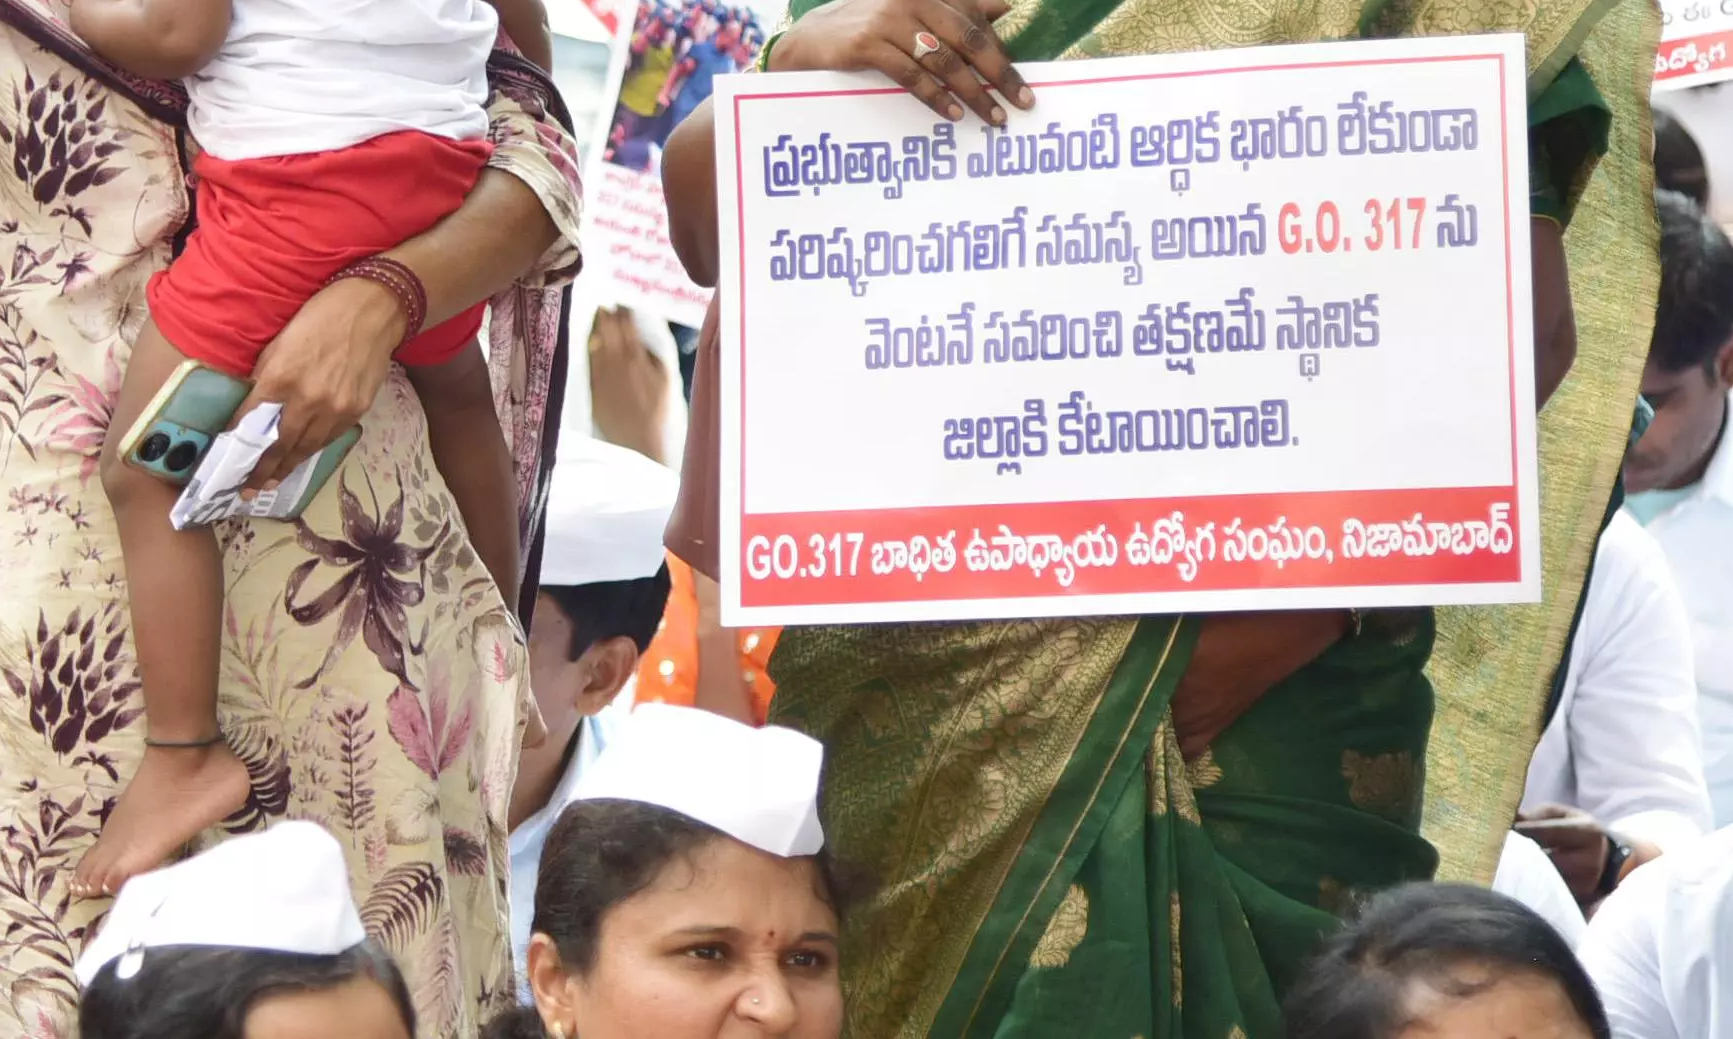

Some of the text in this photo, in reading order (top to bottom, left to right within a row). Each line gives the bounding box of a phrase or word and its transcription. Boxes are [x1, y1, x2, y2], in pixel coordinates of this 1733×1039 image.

[763, 123, 957, 199] ప్రభుత్వానికి
[968, 113, 1120, 177] ఎటువంటి
[1230, 106, 1327, 171] భారం
[1337, 91, 1478, 155] లేకుండా
[770, 194, 1478, 296] పరిష్కరించగలిగే సమస్య అయిన G.O. 317 ను
[865, 287, 1380, 381] వెంటనే సవరించి తక్షణమే స్థానిక
[943, 391, 1299, 475] జిల్లాకి కేటాయించాలి.
[746, 503, 1513, 587] GO.317 బాధిత ఉపాధ్యాయ ఉద్యోగ సంఘం, నిజామాబాద్
